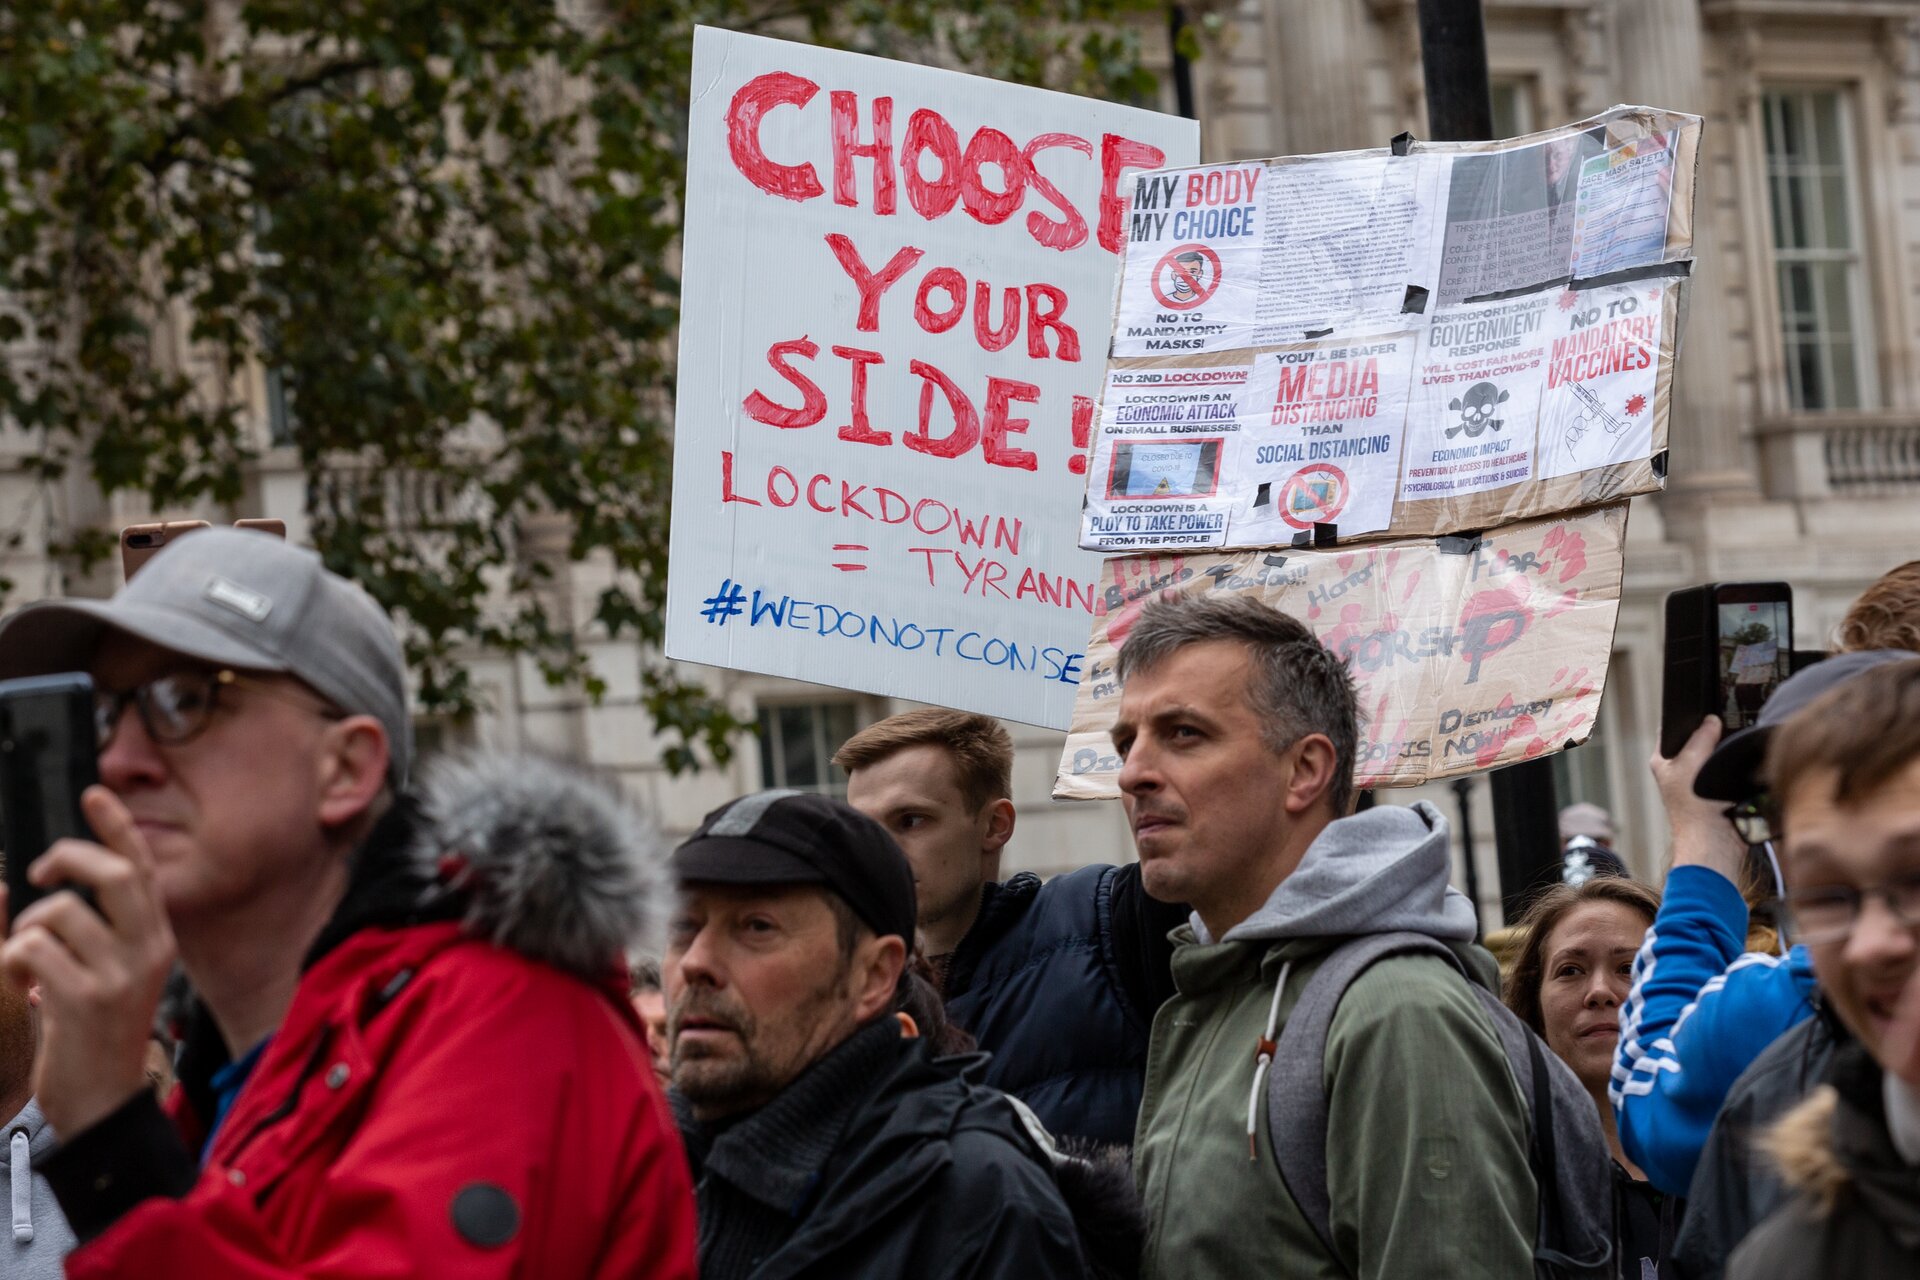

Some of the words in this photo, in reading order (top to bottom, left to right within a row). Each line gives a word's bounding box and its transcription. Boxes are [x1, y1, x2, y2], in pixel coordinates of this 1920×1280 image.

[724, 71, 1166, 254] CHOOSE
[1581, 174, 1605, 186] FACE
[1605, 163, 1627, 178] MASK
[1629, 151, 1665, 167] SAFETY
[1134, 175, 1180, 210] MY
[1186, 167, 1261, 207] BODY
[1131, 212, 1169, 242] MY
[1173, 206, 1257, 241] CHOICE
[825, 233, 1081, 362] YOUR
[1156, 314, 1178, 323] NO
[1182, 312, 1203, 323] TO
[1570, 307, 1602, 331] NO
[1607, 296, 1638, 319] TO
[1127, 324, 1228, 337] MANDATORY
[1429, 309, 1546, 348] GOVERNMENT
[1551, 314, 1658, 362] MANDATORY
[1146, 338, 1205, 350] MASKS!
[1330, 348, 1348, 360] BE
[1350, 343, 1397, 358] SAFER
[1448, 336, 1521, 358] RESPONSE
[1421, 374, 1455, 385] LIVES
[1458, 369, 1491, 383] THAN
[1492, 359, 1541, 377] COVID-19
[1422, 363, 1451, 375] WILL
[1454, 359, 1485, 371] COST
[1486, 355, 1509, 367] FAR
[1510, 347, 1544, 362] MORE
[1547, 339, 1653, 390] VACCINES
[1112, 374, 1133, 383] NO
[1135, 373, 1162, 383] 2ND
[1276, 357, 1379, 404] MEDIA
[743, 335, 1093, 475] SIDE!
[1116, 404, 1185, 421] ECONOMIC
[1186, 402, 1238, 420] ATTACK
[1125, 395, 1198, 404] LOCKDOWN
[1200, 394, 1210, 402] IS
[1212, 393, 1231, 402] AN
[1271, 396, 1378, 426] DISTANCING
[1105, 426, 1123, 434] ON
[1125, 425, 1168, 434] SMALL
[1169, 424, 1242, 434] BUSINESSES!
[1301, 423, 1343, 437] THAN
[1256, 441, 1306, 465] SOCIAL
[1309, 434, 1390, 461] DISTANCING
[1432, 445, 1478, 463] ECONOMIC
[1479, 438, 1512, 456] IMPACT
[1409, 466, 1448, 478] PREVENTION
[1449, 465, 1458, 474] OF
[1458, 461, 1481, 473] ACCESS
[1482, 459, 1491, 469] TO
[1491, 451, 1528, 467] HEALTHCARE
[1403, 480, 1455, 493] PSYCHOLOGICAL
[1457, 472, 1500, 489] IMPLICATIONS
[1506, 466, 1529, 480] SUICIDE
[722, 451, 1022, 556] LOCKDOWN
[1110, 505, 1183, 514] LOCKDOWN
[1185, 504, 1196, 512] IS
[1198, 503, 1208, 512] A
[1090, 516, 1123, 532] PLOY
[1126, 515, 1141, 531] TO
[1145, 514, 1177, 531] TAKE
[1178, 513, 1224, 530] POWER
[1098, 537, 1136, 546] FROM
[1138, 536, 1160, 545] THE
[1162, 535, 1211, 544] PEOPLE!
[908, 547, 1094, 615] TYRANN
[700, 578, 1085, 685] #WEDONOTCONSE
